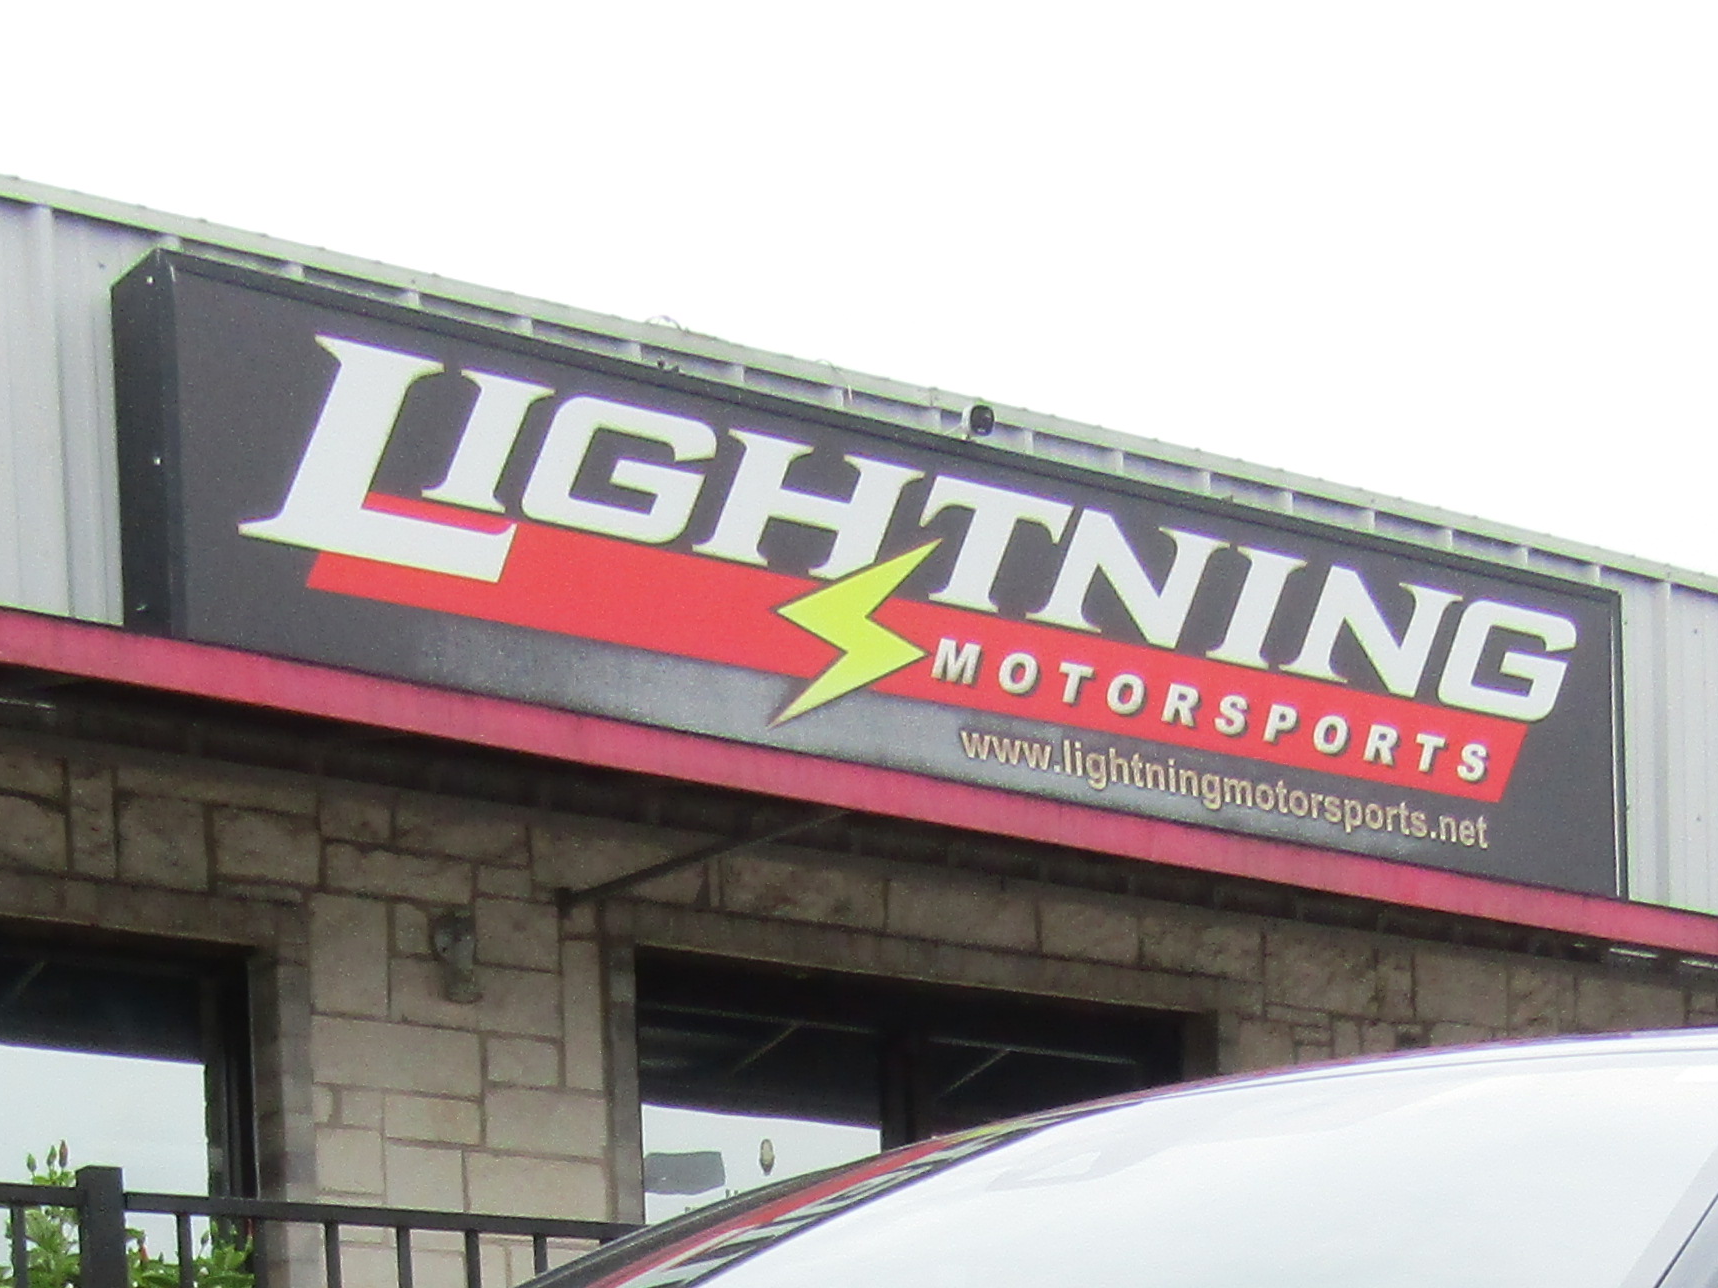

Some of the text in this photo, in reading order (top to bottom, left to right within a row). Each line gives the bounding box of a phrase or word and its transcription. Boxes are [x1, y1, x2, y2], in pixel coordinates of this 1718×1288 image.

[236, 333, 1580, 723] LIGHTNING
[930, 634, 1491, 783] MOTORSPORTS
[959, 727, 1490, 850] www.lightningmotorsports.net
